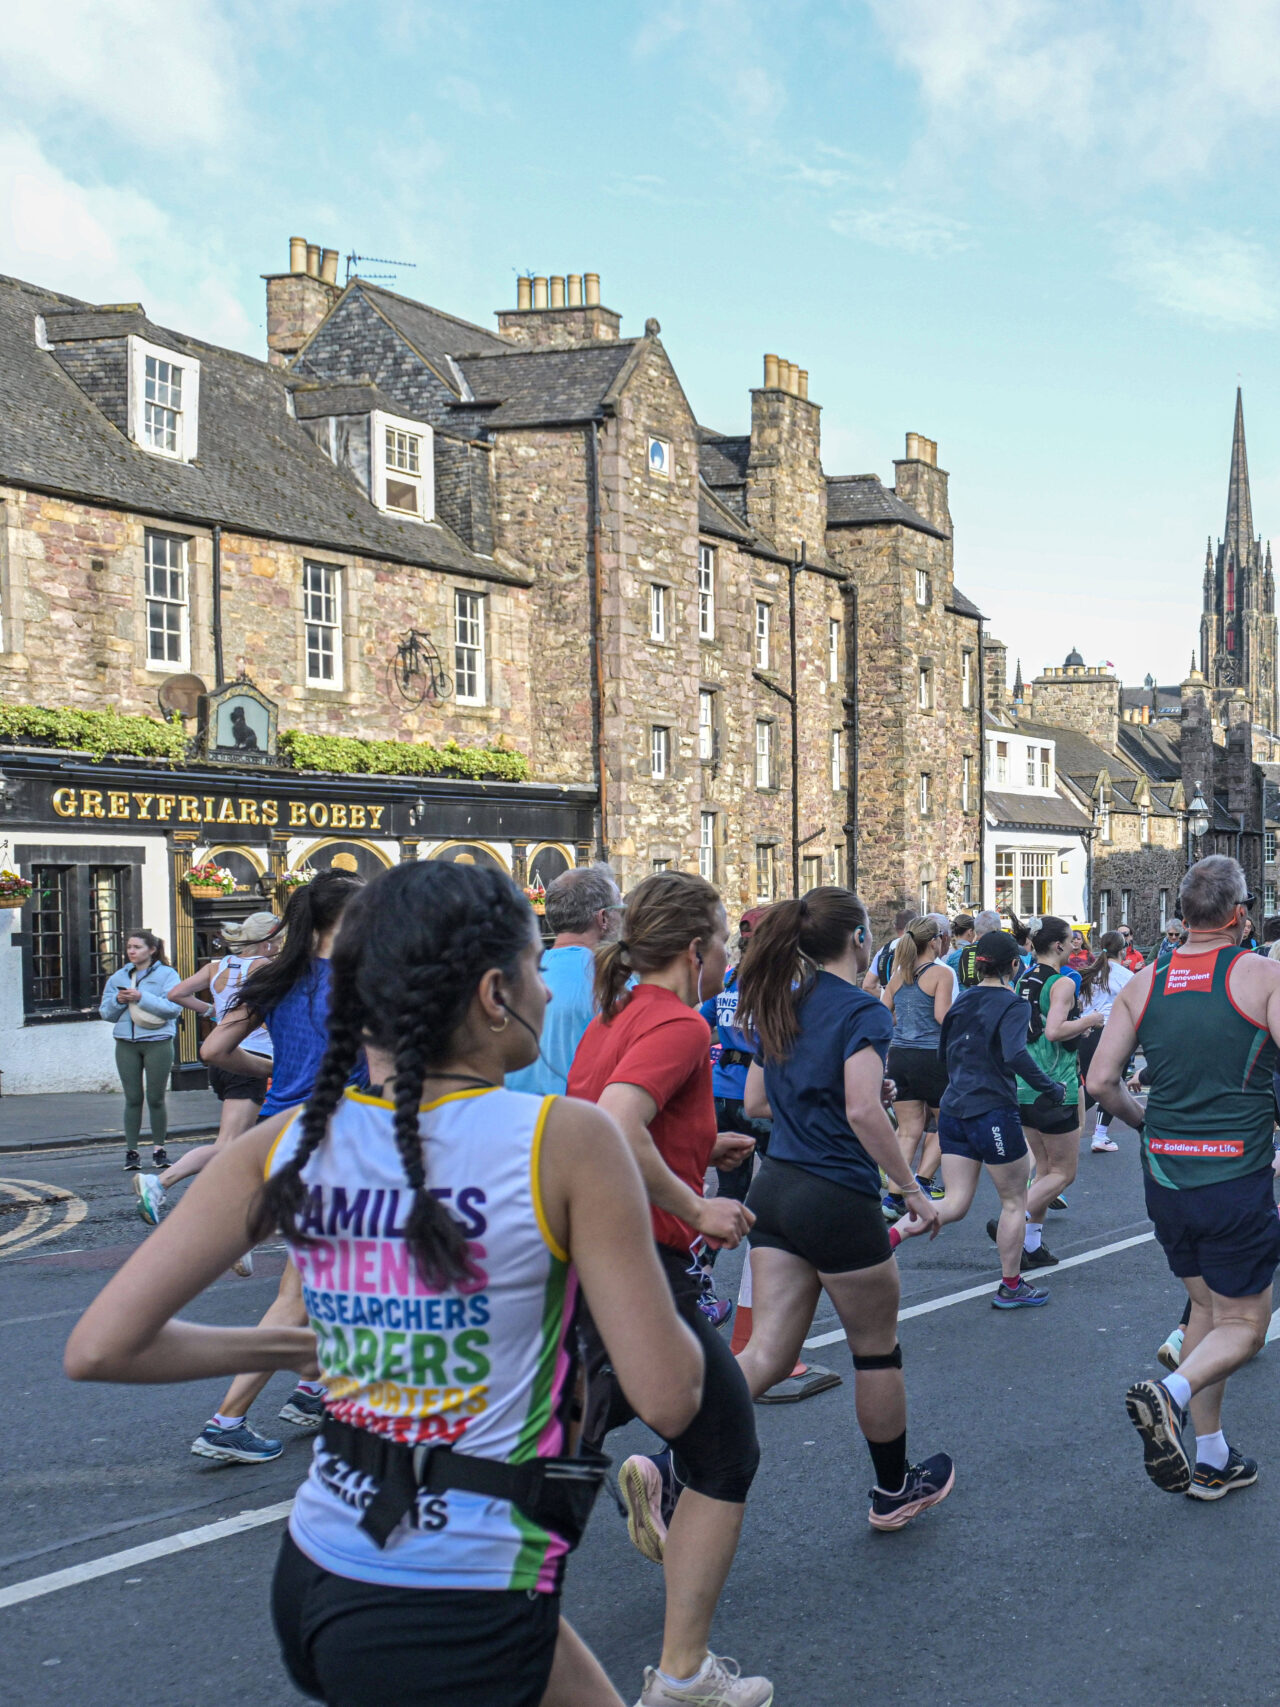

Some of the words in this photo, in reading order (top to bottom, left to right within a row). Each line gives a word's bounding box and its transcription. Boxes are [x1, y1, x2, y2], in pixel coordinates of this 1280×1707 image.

[52, 787, 279, 826] GREYFRIARS
[288, 801, 385, 829] BOBBY
[1169, 972, 1210, 982] Benevolent
[1170, 968, 1191, 976] Army
[991, 1125, 1005, 1157] SAYSKY
[1163, 1143, 1200, 1152] Soldiers.
[1202, 1144, 1217, 1152] For
[1219, 1144, 1239, 1153] Life.
[302, 1184, 487, 1239] AMILS
